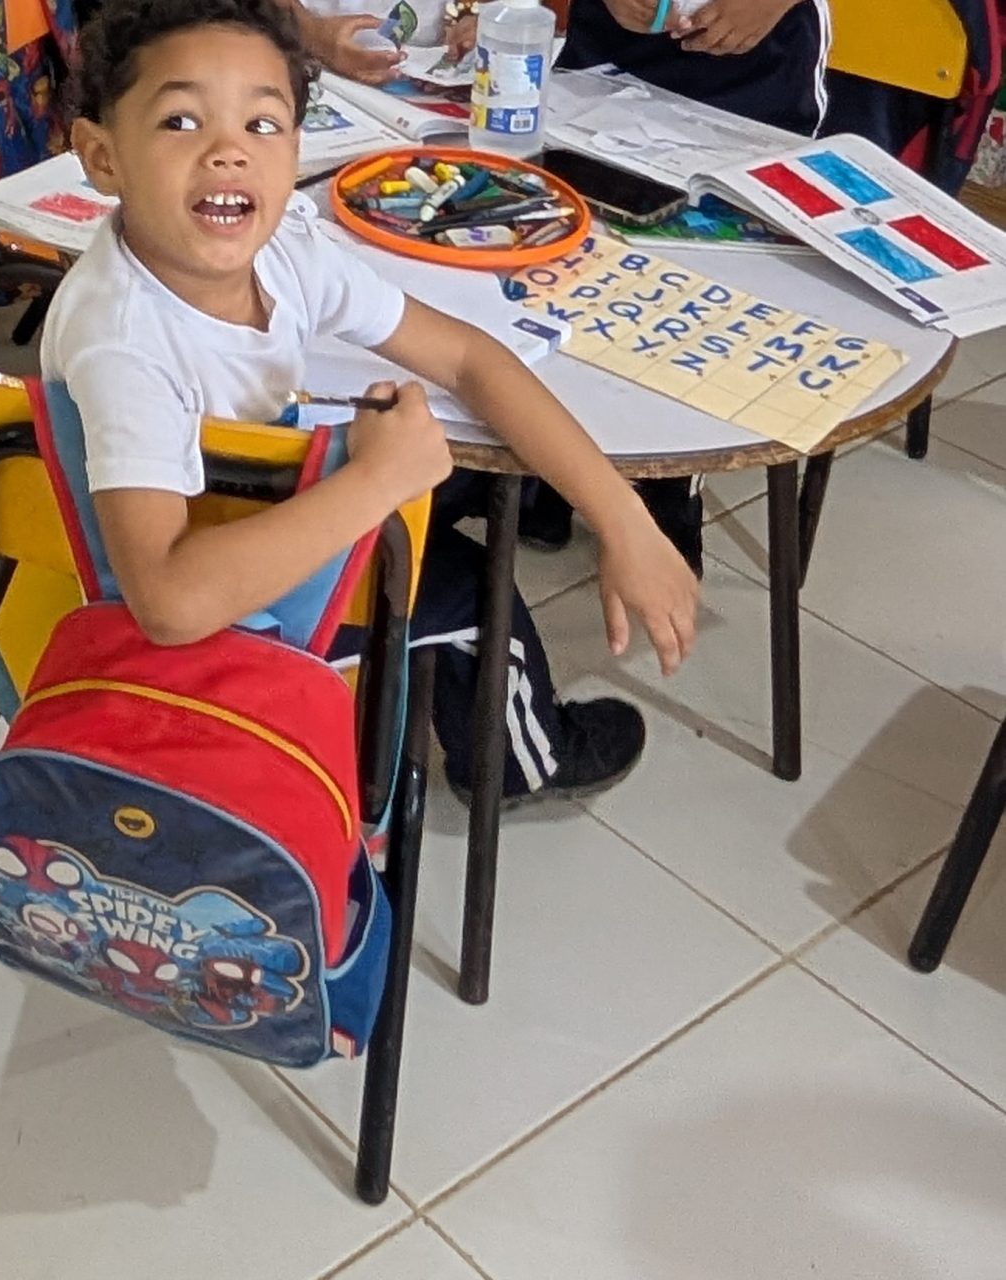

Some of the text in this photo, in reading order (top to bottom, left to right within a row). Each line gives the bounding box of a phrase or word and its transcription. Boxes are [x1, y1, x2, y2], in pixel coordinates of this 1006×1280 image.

[527, 268, 834, 391] O P Q R S T U
[582, 316, 617, 342] X
[631, 334, 666, 353] Y
[670, 350, 709, 372] Z
[619, 253, 651, 272] B
[659, 271, 691, 290] C
[699, 284, 733, 305] D
[742, 302, 783, 321] E
[791, 320, 830, 336] F
[834, 336, 870, 351] G
[632, 287, 664, 302] J
[678, 300, 712, 321] K
[725, 320, 751, 337] L
[763, 335, 805, 361] M
[817, 354, 861, 372] N
[68, 889, 212, 942] SPIDEY
